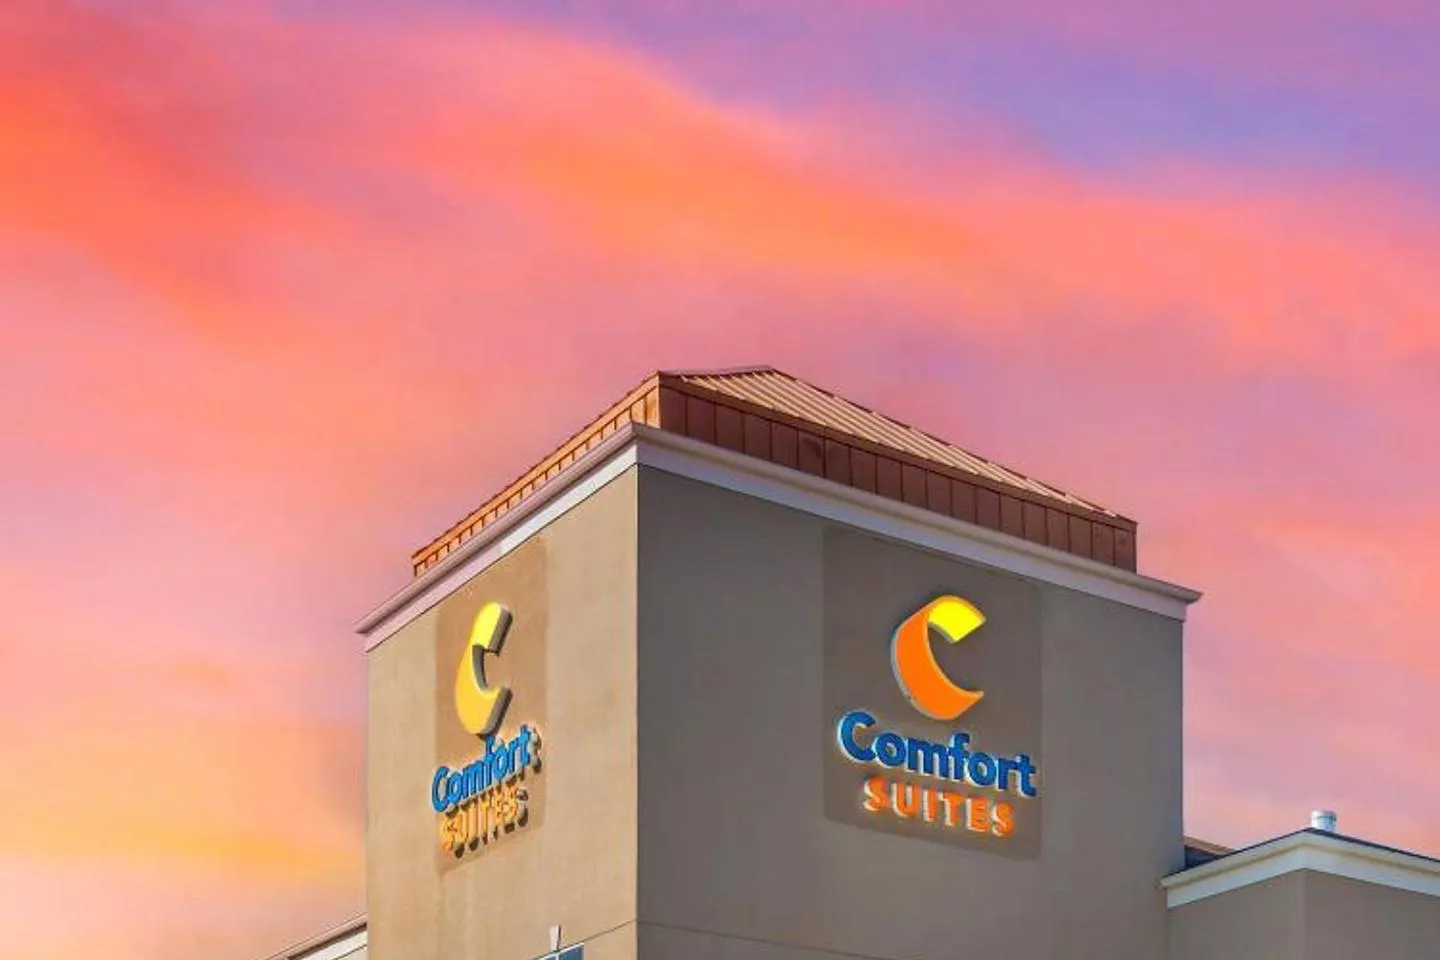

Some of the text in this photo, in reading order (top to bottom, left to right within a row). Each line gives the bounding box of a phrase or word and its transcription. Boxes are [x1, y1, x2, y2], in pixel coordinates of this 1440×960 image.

[432, 723, 533, 813] Comfort
[837, 709, 1037, 798] Comfort
[863, 776, 1015, 837] SUITES
